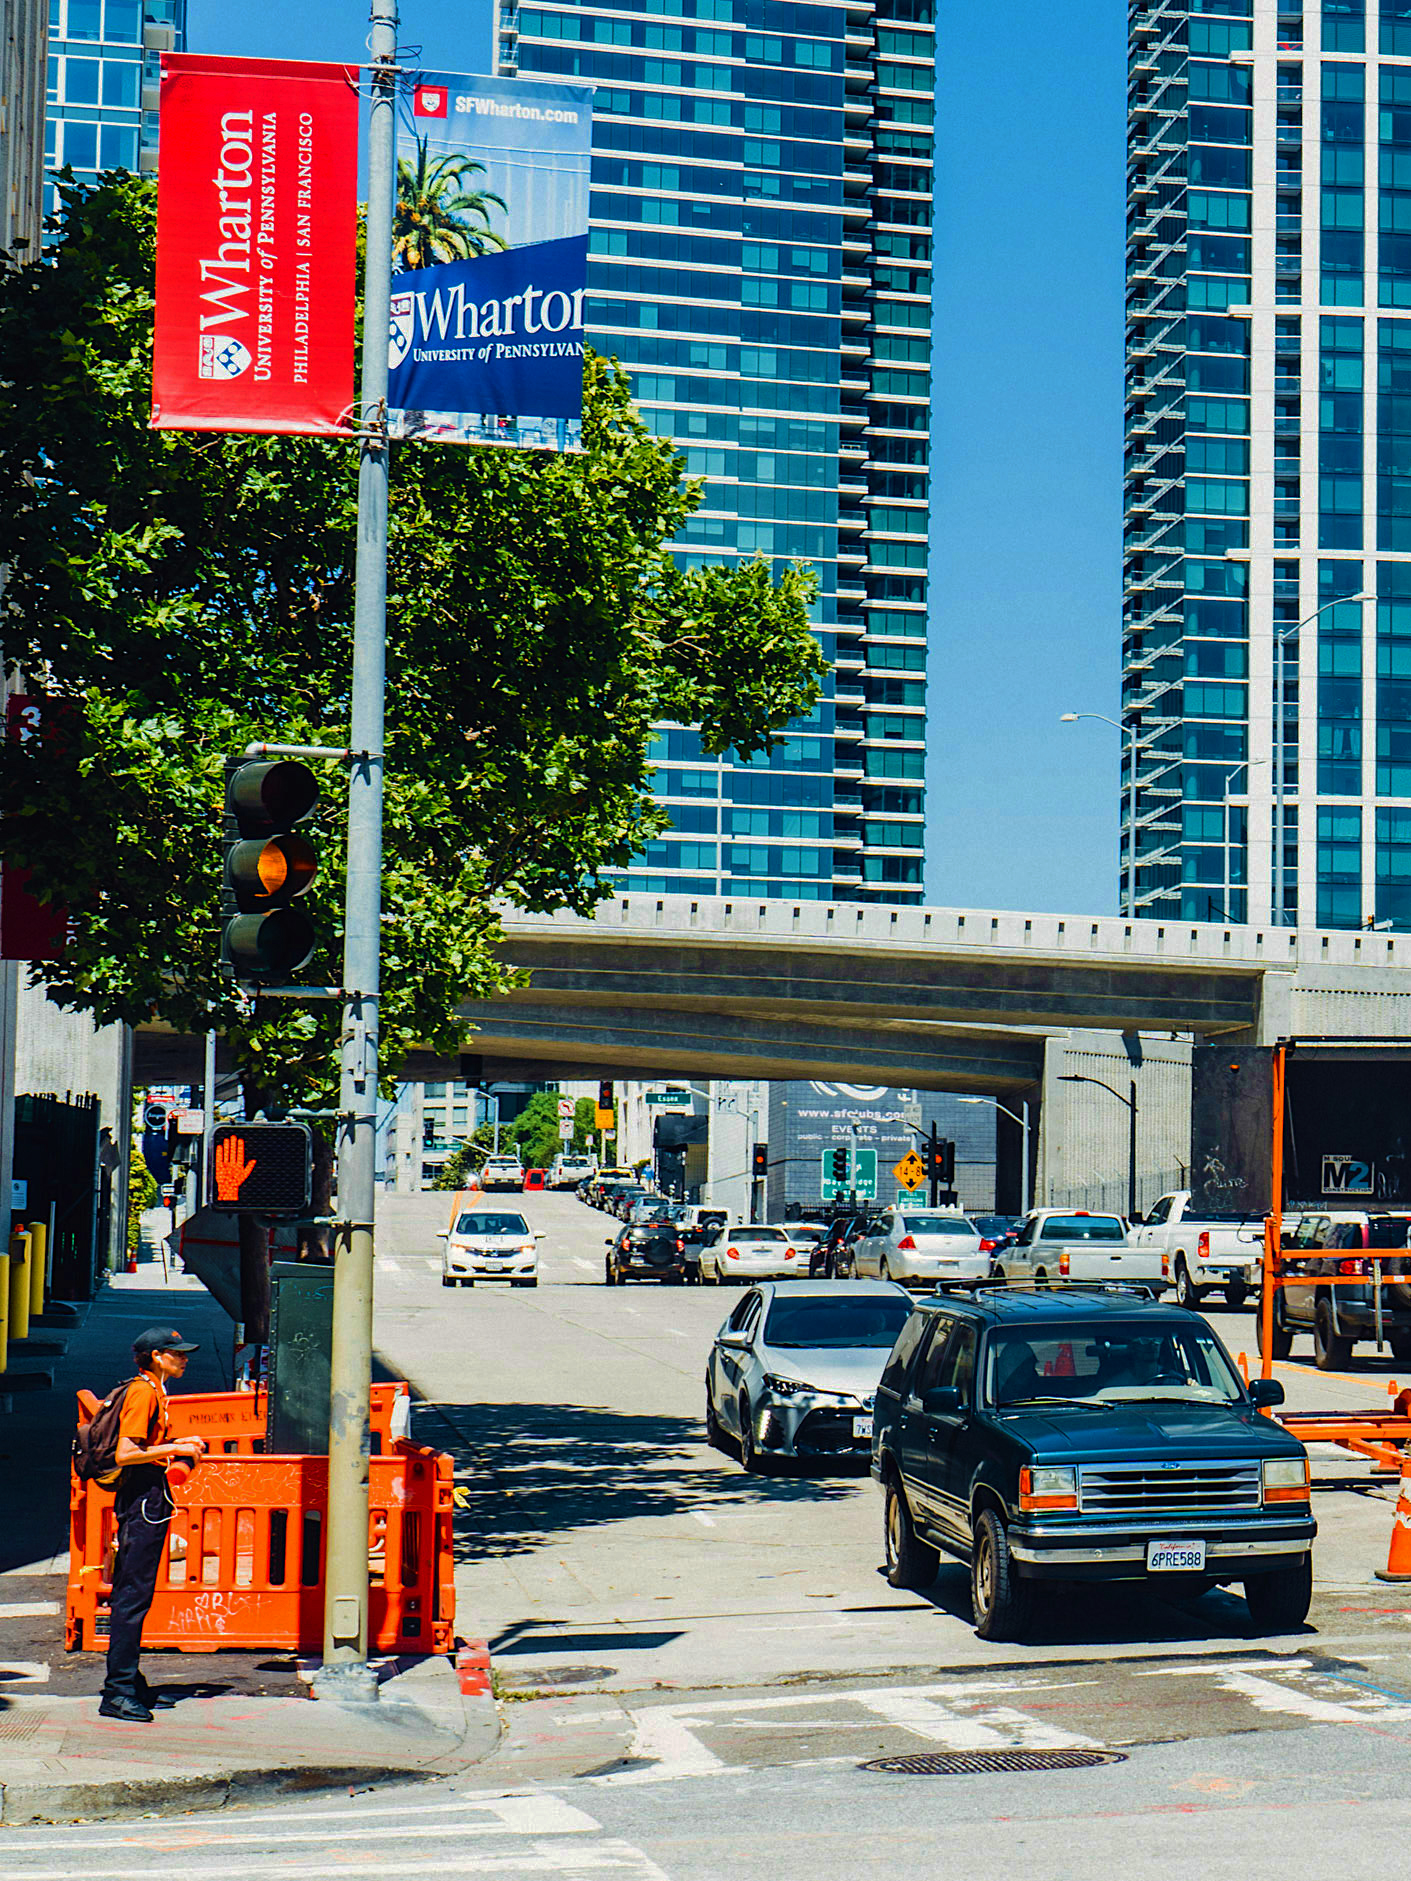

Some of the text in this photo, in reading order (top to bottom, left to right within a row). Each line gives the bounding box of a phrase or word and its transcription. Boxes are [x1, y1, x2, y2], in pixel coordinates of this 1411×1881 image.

[455, 96, 578, 125] SFWharton.com
[199, 109, 253, 331] Wharton
[254, 112, 278, 381] UNIVERSITY of PENNSYLVANIA
[294, 112, 313, 383] PHILADELPHIA SAN FRANCISCO
[413, 348, 475, 362] UNIVERSITY
[478, 342, 494, 364] of
[1151, 1551, 1202, 1567] 6PRE588
